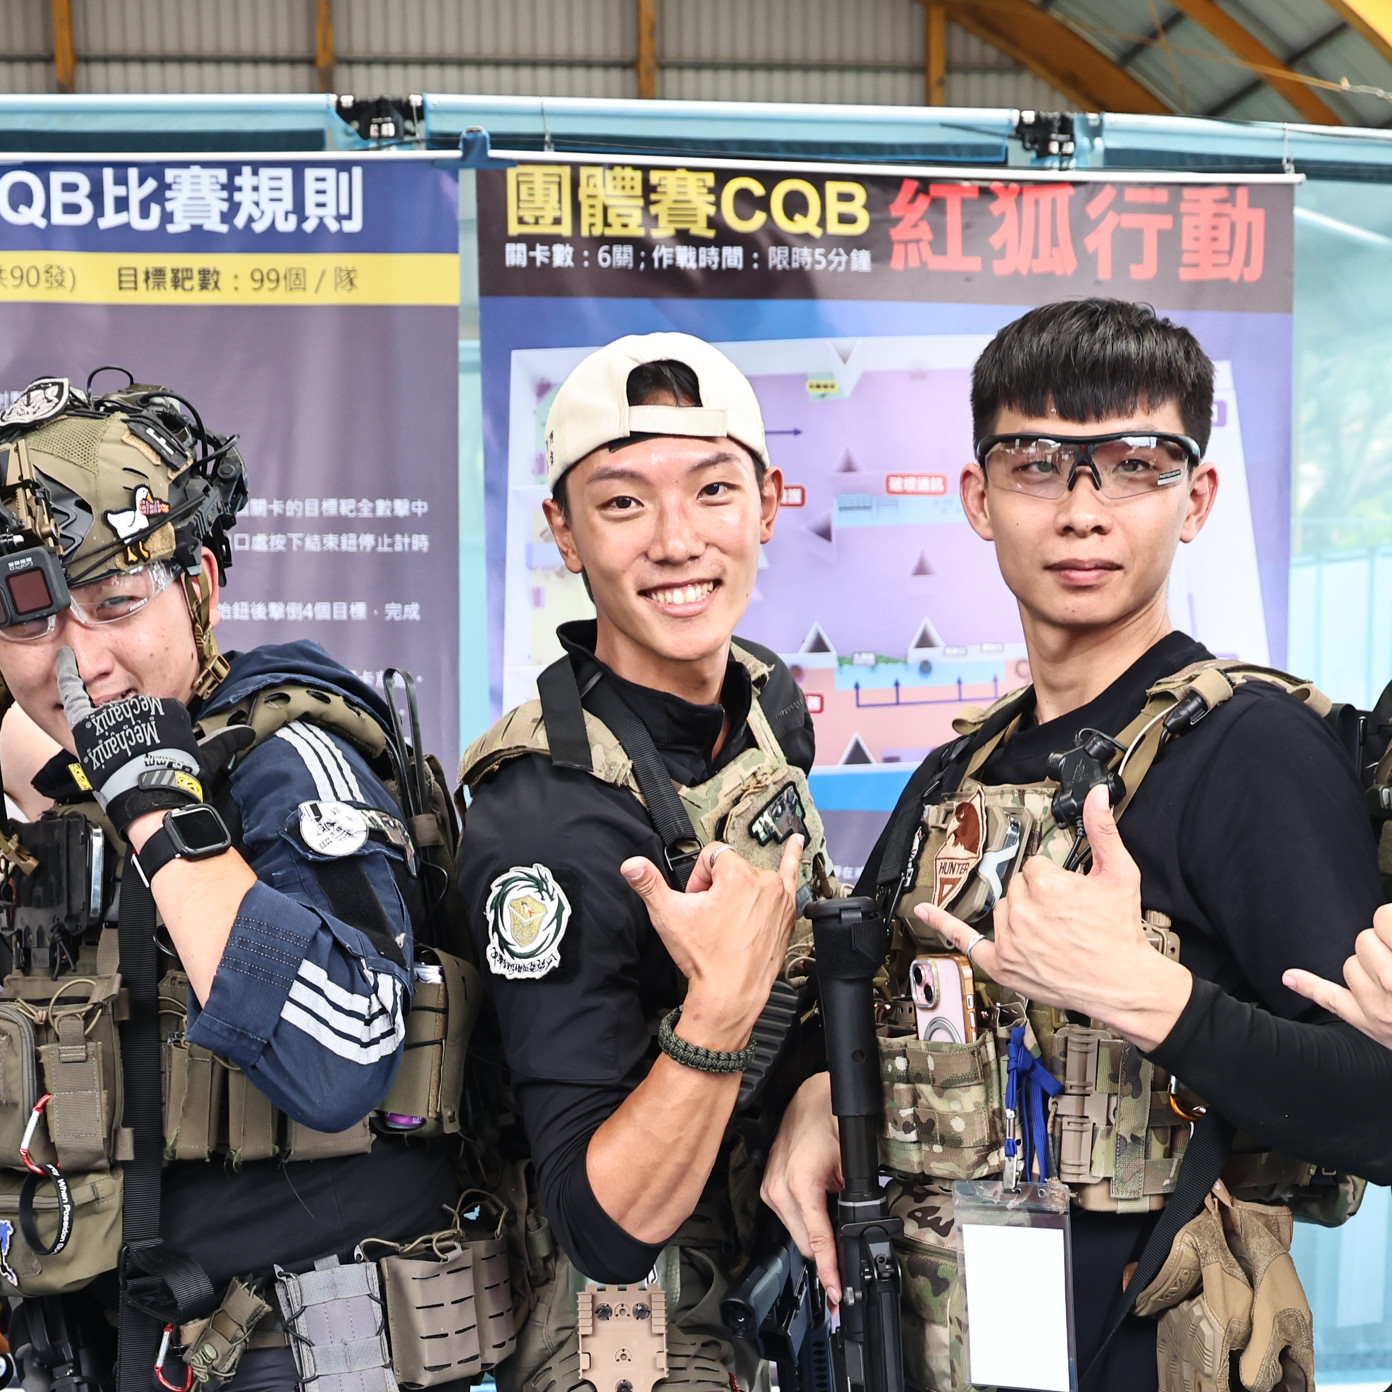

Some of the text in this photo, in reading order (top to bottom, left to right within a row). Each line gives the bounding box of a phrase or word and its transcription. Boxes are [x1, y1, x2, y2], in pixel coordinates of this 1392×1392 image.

[505, 164, 871, 239] 團體賽CQB
[888, 178, 1267, 283] 紅狐行動
[334, 266, 359, 293] 隊
[230, 532, 430, 553] 口處按下結束鈕停止計時
[938, 861, 970, 875] HUNTER
[57, 1178, 69, 1203] When
[59, 1204, 71, 1242] Poseidon
